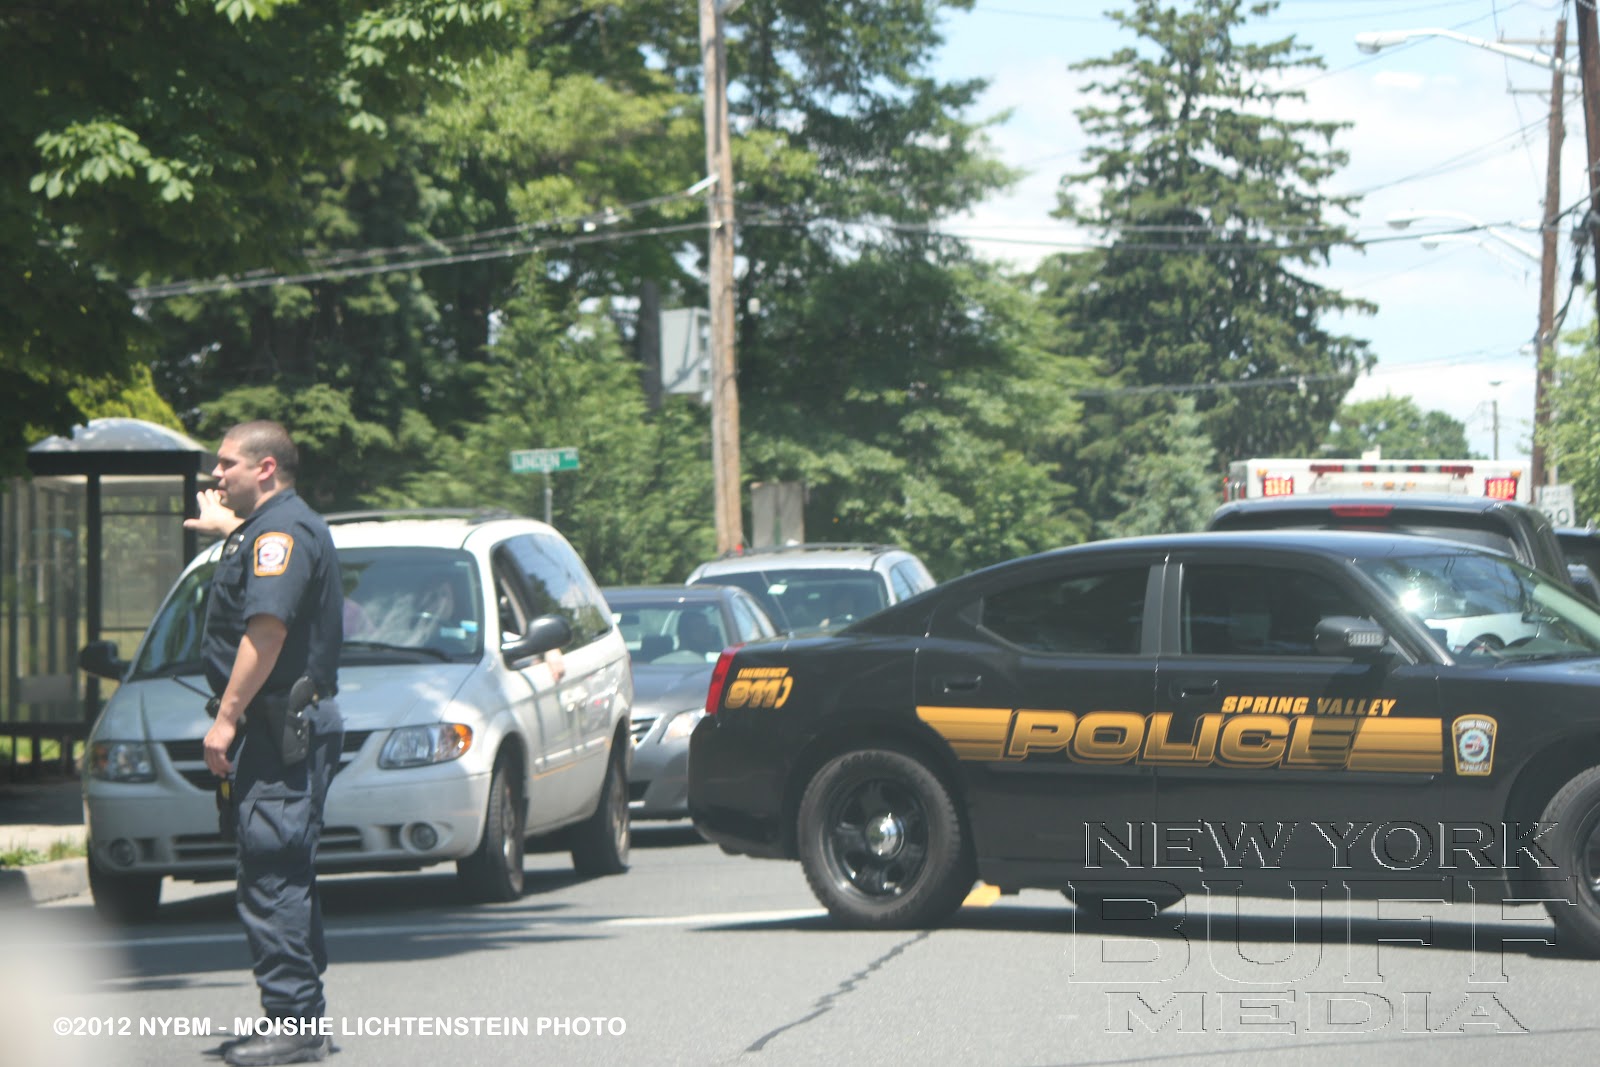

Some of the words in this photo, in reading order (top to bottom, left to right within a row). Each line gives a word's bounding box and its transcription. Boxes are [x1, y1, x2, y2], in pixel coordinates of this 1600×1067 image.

[513, 453, 560, 470] LINDEN
[737, 667, 789, 678] EMERGENCY
[725, 679, 783, 709] 911
[1221, 696, 1310, 714] SPRING
[1316, 697, 1397, 717] VALLEY
[1003, 709, 1358, 769] POLICE
